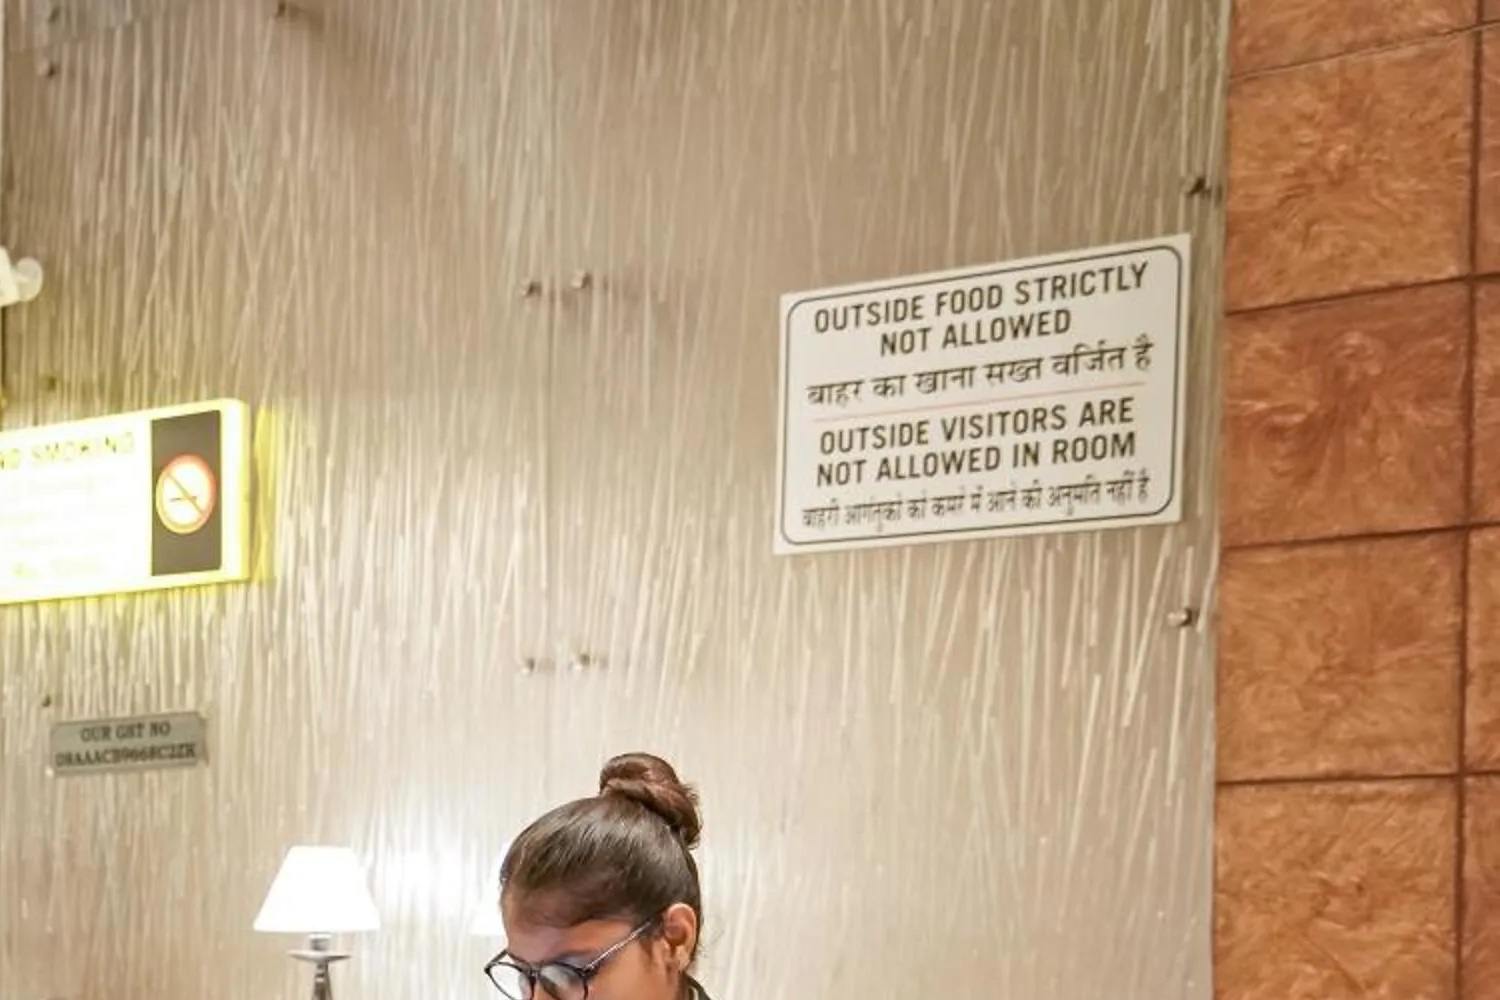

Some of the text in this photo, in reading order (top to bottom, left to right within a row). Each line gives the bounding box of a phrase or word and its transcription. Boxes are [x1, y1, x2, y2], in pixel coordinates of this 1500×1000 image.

[814, 261, 1149, 334] OUTSIDE FOOD STRICTLY
[880, 308, 1071, 358] NOT ALLOWED
[870, 375, 907, 398] का
[912, 365, 977, 394] खाना
[1050, 339, 1128, 376] वर्जित
[1132, 333, 1155, 371] है
[820, 396, 1136, 456] OUTSIDE VISITORS ARE
[816, 431, 1136, 488] NOT ALLOWED IN ROOM
[80, 720, 172, 743] OUR GST NO
